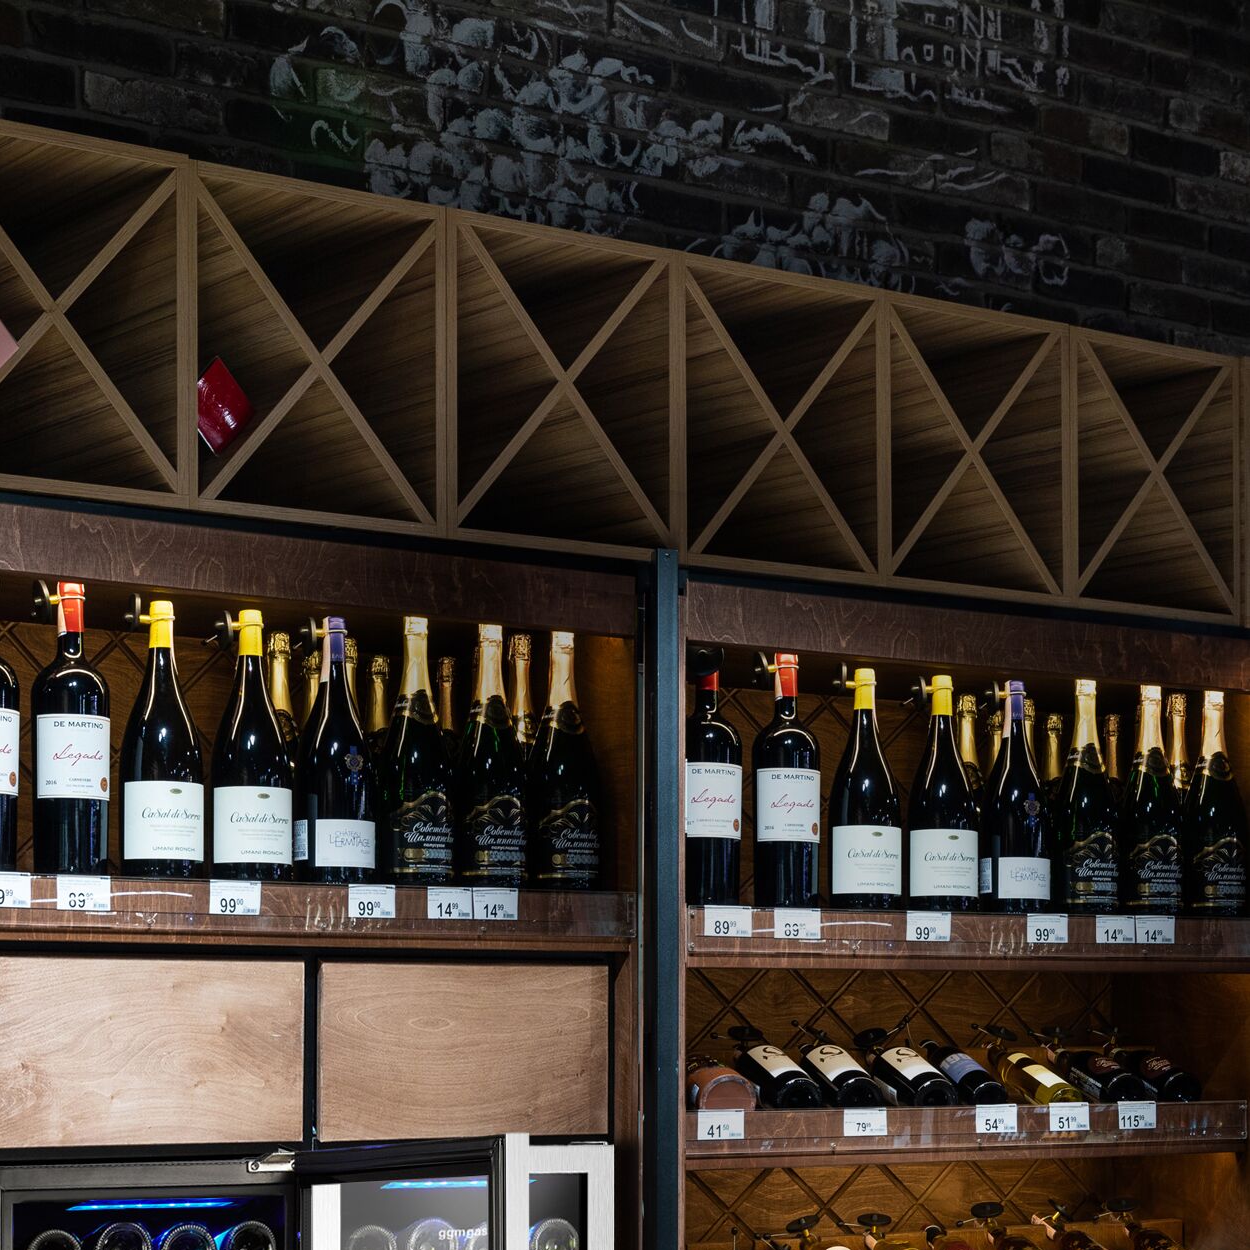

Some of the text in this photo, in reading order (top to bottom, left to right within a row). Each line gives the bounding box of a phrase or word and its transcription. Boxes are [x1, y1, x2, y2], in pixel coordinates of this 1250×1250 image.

[53, 720, 104, 730] DE MARTINO
[52, 743, 103, 766] Legado
[704, 768, 736, 777] MARTINO
[784, 774, 815, 782] MARTINO
[691, 789, 736, 809] Legado
[771, 794, 815, 814] Legado
